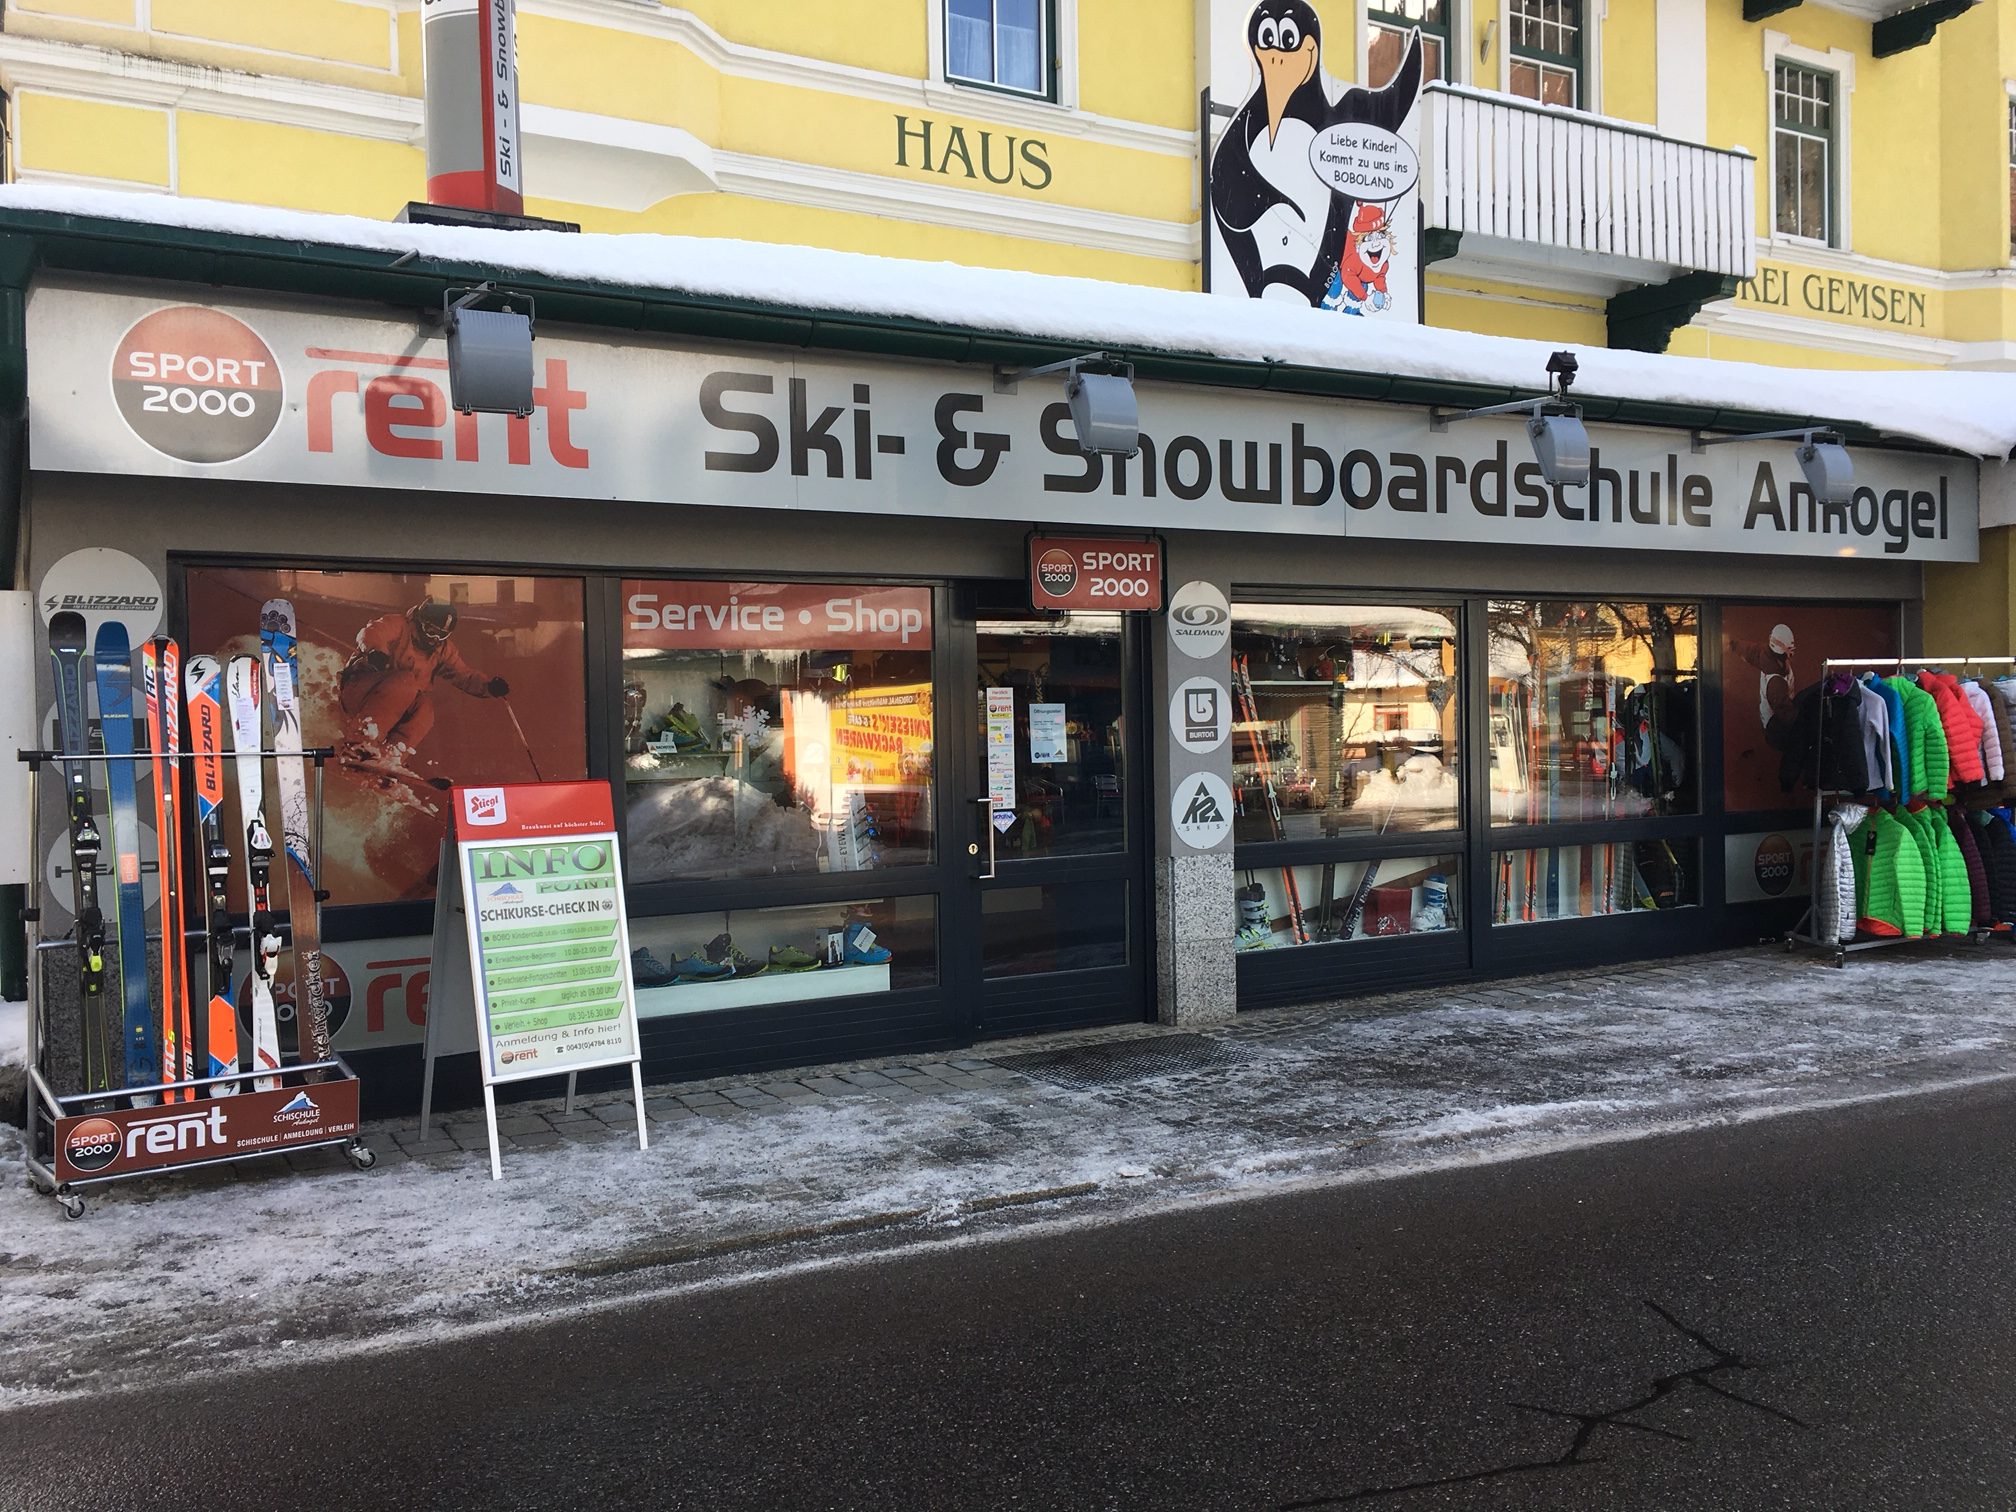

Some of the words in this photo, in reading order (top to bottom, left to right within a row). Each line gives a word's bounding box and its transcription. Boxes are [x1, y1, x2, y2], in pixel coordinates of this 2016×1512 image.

[497, 89, 509, 109] &
[893, 114, 1053, 190] HAUS
[1330, 133, 1358, 148] Liebe
[1362, 138, 1398, 154] Kinder!
[499, 135, 512, 178] Ski
[1319, 151, 1354, 166] Kommt
[1358, 158, 1369, 168] zu
[1373, 160, 1390, 171] uns
[1394, 160, 1408, 174] ins
[1334, 170, 1394, 190] BOBOLAND
[1802, 273, 1926, 328] GEMSEN
[129, 351, 266, 386] SPORT
[142, 385, 256, 418] 2000
[699, 370, 906, 481] Ski-
[934, 392, 1011, 487] &
[1039, 402, 1713, 527] Snowboardschule
[1041, 564, 1073, 573] SPORT
[1083, 552, 1155, 571] SPORT
[1045, 573, 1071, 582] 2000
[1090, 578, 1149, 597] 2000
[628, 593, 785, 631] Service
[825, 598, 922, 644] Shop
[1189, 731, 1214, 739] BURTON
[471, 795, 499, 813] Stiegl
[479, 844, 607, 879] INFO
[1758, 852, 1791, 865] SPORT
[1761, 866, 1789, 878] 2000
[480, 902, 585, 921] SCHIKURSE-CHECK
[587, 900, 600, 912] IN
[604, 986, 615, 994] Uhr
[306, 949, 331, 1061] ushwacker
[532, 1017, 548, 1027] Shop
[604, 1008, 615, 1016] Uhr
[496, 1032, 558, 1048] Anmeldung
[562, 1030, 570, 1038] &
[574, 1027, 595, 1037] Info
[598, 1023, 621, 1033] hier!
[514, 1048, 538, 1061] rent
[607, 1037, 622, 1045] 8110
[273, 1109, 320, 1123] SCHISCHULE
[70, 1131, 117, 1148] SPORT
[126, 1106, 227, 1158] rent
[237, 1135, 278, 1147] SCHISCHULE
[283, 1127, 323, 1140] ANMELDUNG
[328, 1123, 355, 1133] VERLEIH
[75, 1143, 113, 1157] 2000
